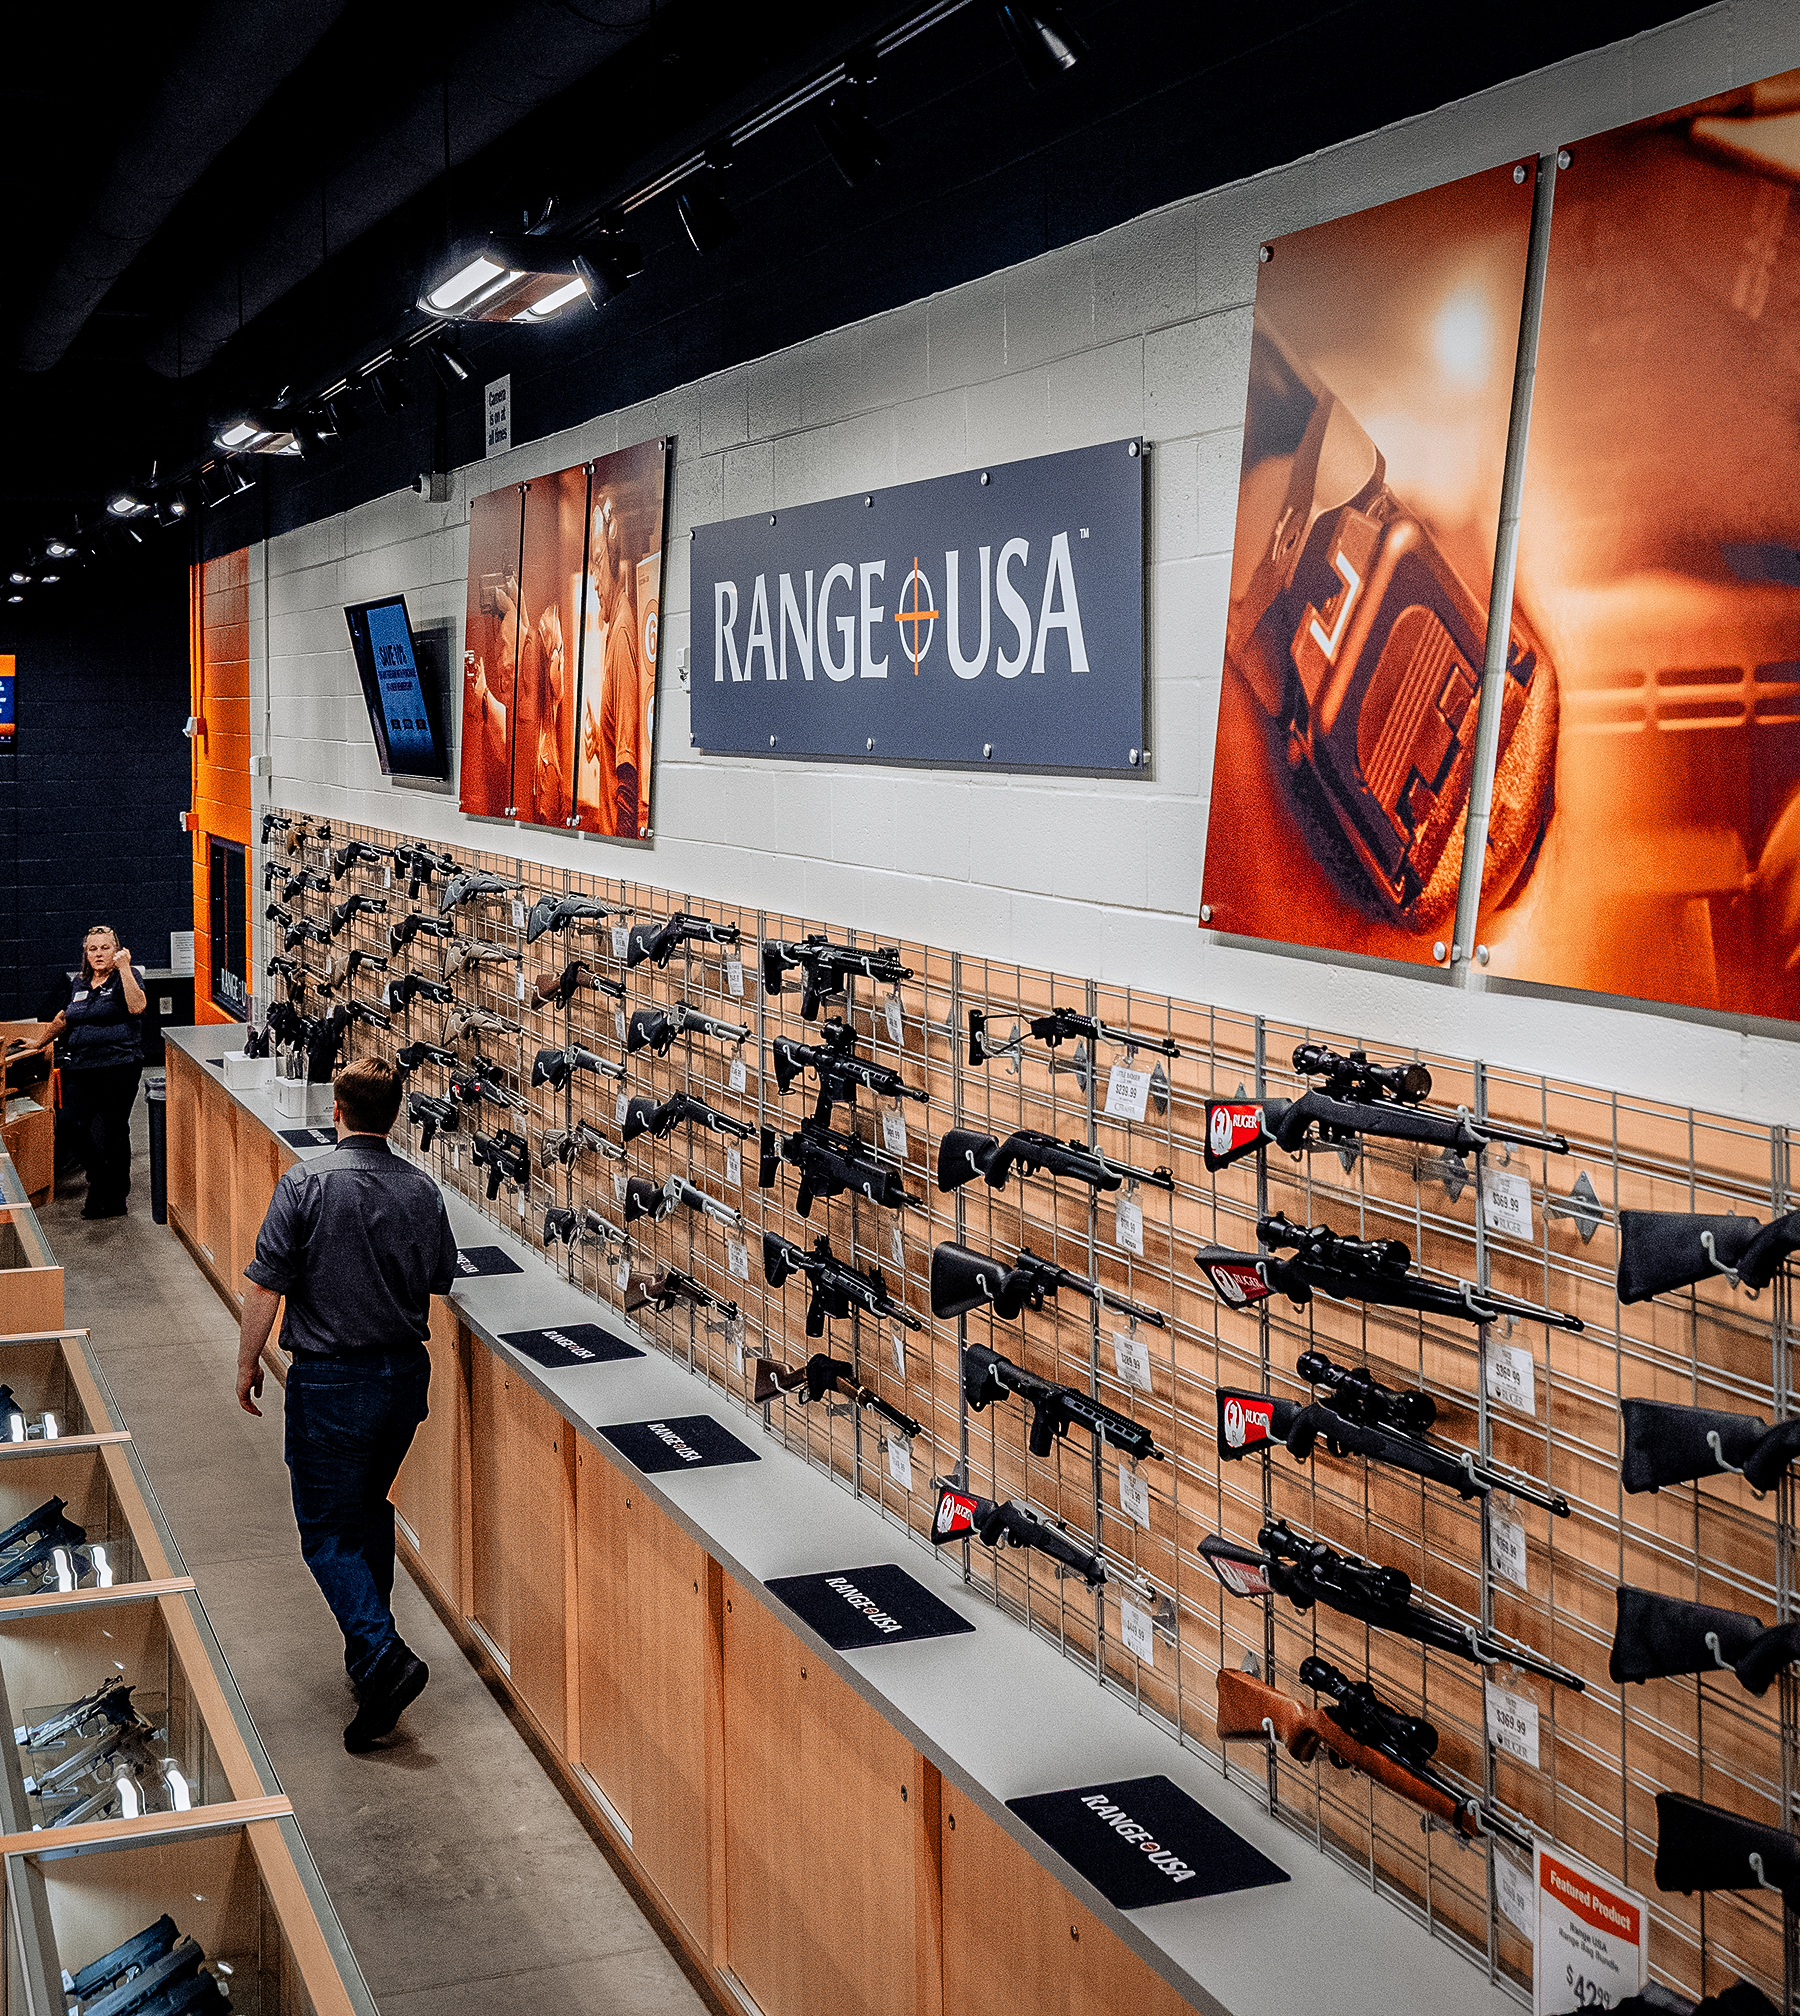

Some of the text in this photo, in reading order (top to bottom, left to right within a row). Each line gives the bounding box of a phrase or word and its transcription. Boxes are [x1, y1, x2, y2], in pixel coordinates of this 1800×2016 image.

[488, 389, 507, 408] Camera
[490, 406, 506, 426] is on at
[495, 427, 508, 444] times
[714, 559, 889, 682] RANGE
[945, 530, 1091, 681] USA
[1232, 1114, 1258, 1129] RUGER
[1500, 1218, 1523, 1235] RUGER
[1231, 1273, 1264, 1289] RUGER
[541, 1331, 595, 1359] RANGE USA
[647, 1423, 702, 1462] RANGE USA
[825, 1577, 902, 1634] RANGE USA
[1496, 1709, 1526, 1737] $369.99
[1504, 1737, 1528, 1759] RUGER
[1080, 1794, 1196, 1883] RANGE USA
[1550, 1869, 1591, 1908] Featured
[1592, 1894, 1632, 1932] Product
[1558, 1926, 1580, 1948] Range
[1580, 1942, 1594, 1960] Bag
[1569, 1921, 1608, 1953] Range USA
